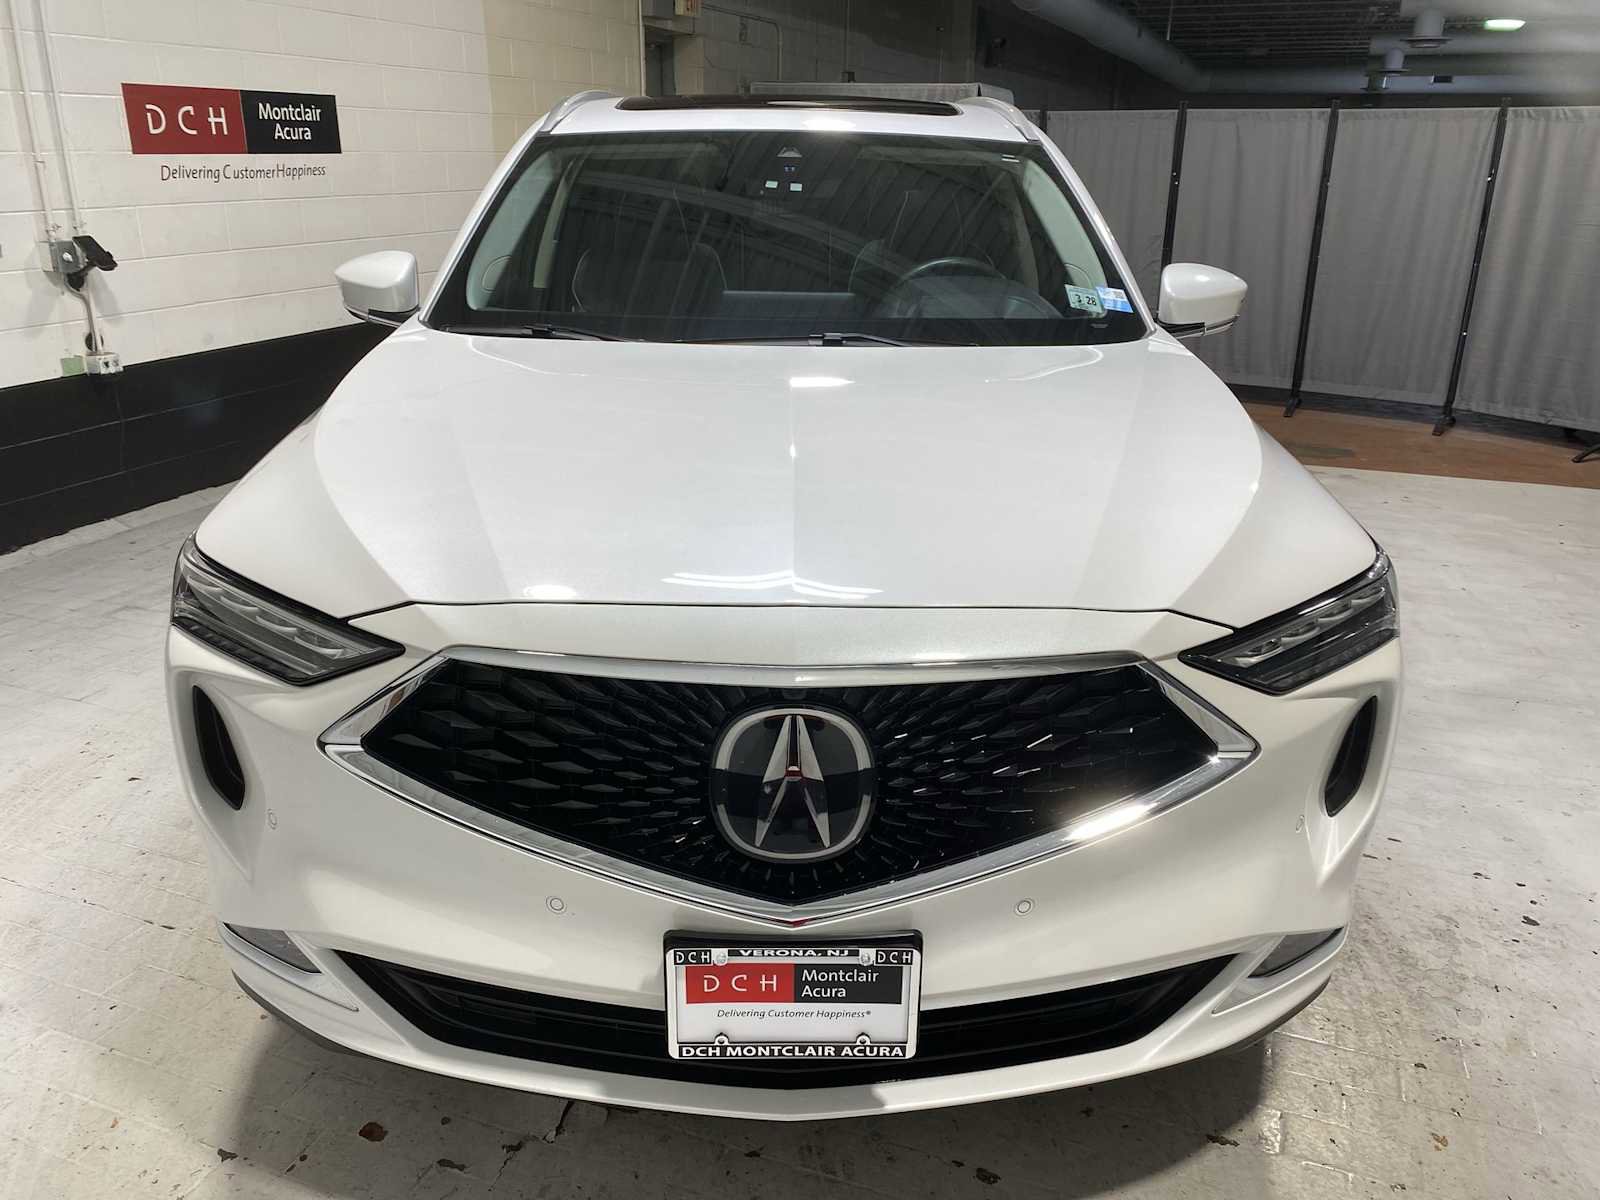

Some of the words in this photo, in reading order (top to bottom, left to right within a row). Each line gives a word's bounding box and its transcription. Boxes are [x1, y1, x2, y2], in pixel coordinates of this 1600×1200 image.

[258, 102, 322, 122] Montclair
[144, 103, 229, 136] DCH
[273, 123, 312, 140] Acura
[160, 164, 220, 184] Delivering
[223, 163, 276, 180] Customer
[276, 163, 326, 183] Happiness
[675, 951, 711, 963] DCH
[739, 949, 822, 957] VERONA,
[827, 949, 849, 957] NJ
[877, 951, 912, 963] DCH
[801, 968, 880, 983] Montclair
[703, 974, 777, 993] DCH
[801, 985, 847, 998] Acura
[717, 1008, 765, 1020] Delivering
[767, 1009, 814, 1018] Customer
[681, 1046, 721, 1058] DCH
[726, 1046, 837, 1057] MONTCLAIR
[841, 1046, 905, 1057] ACURA
